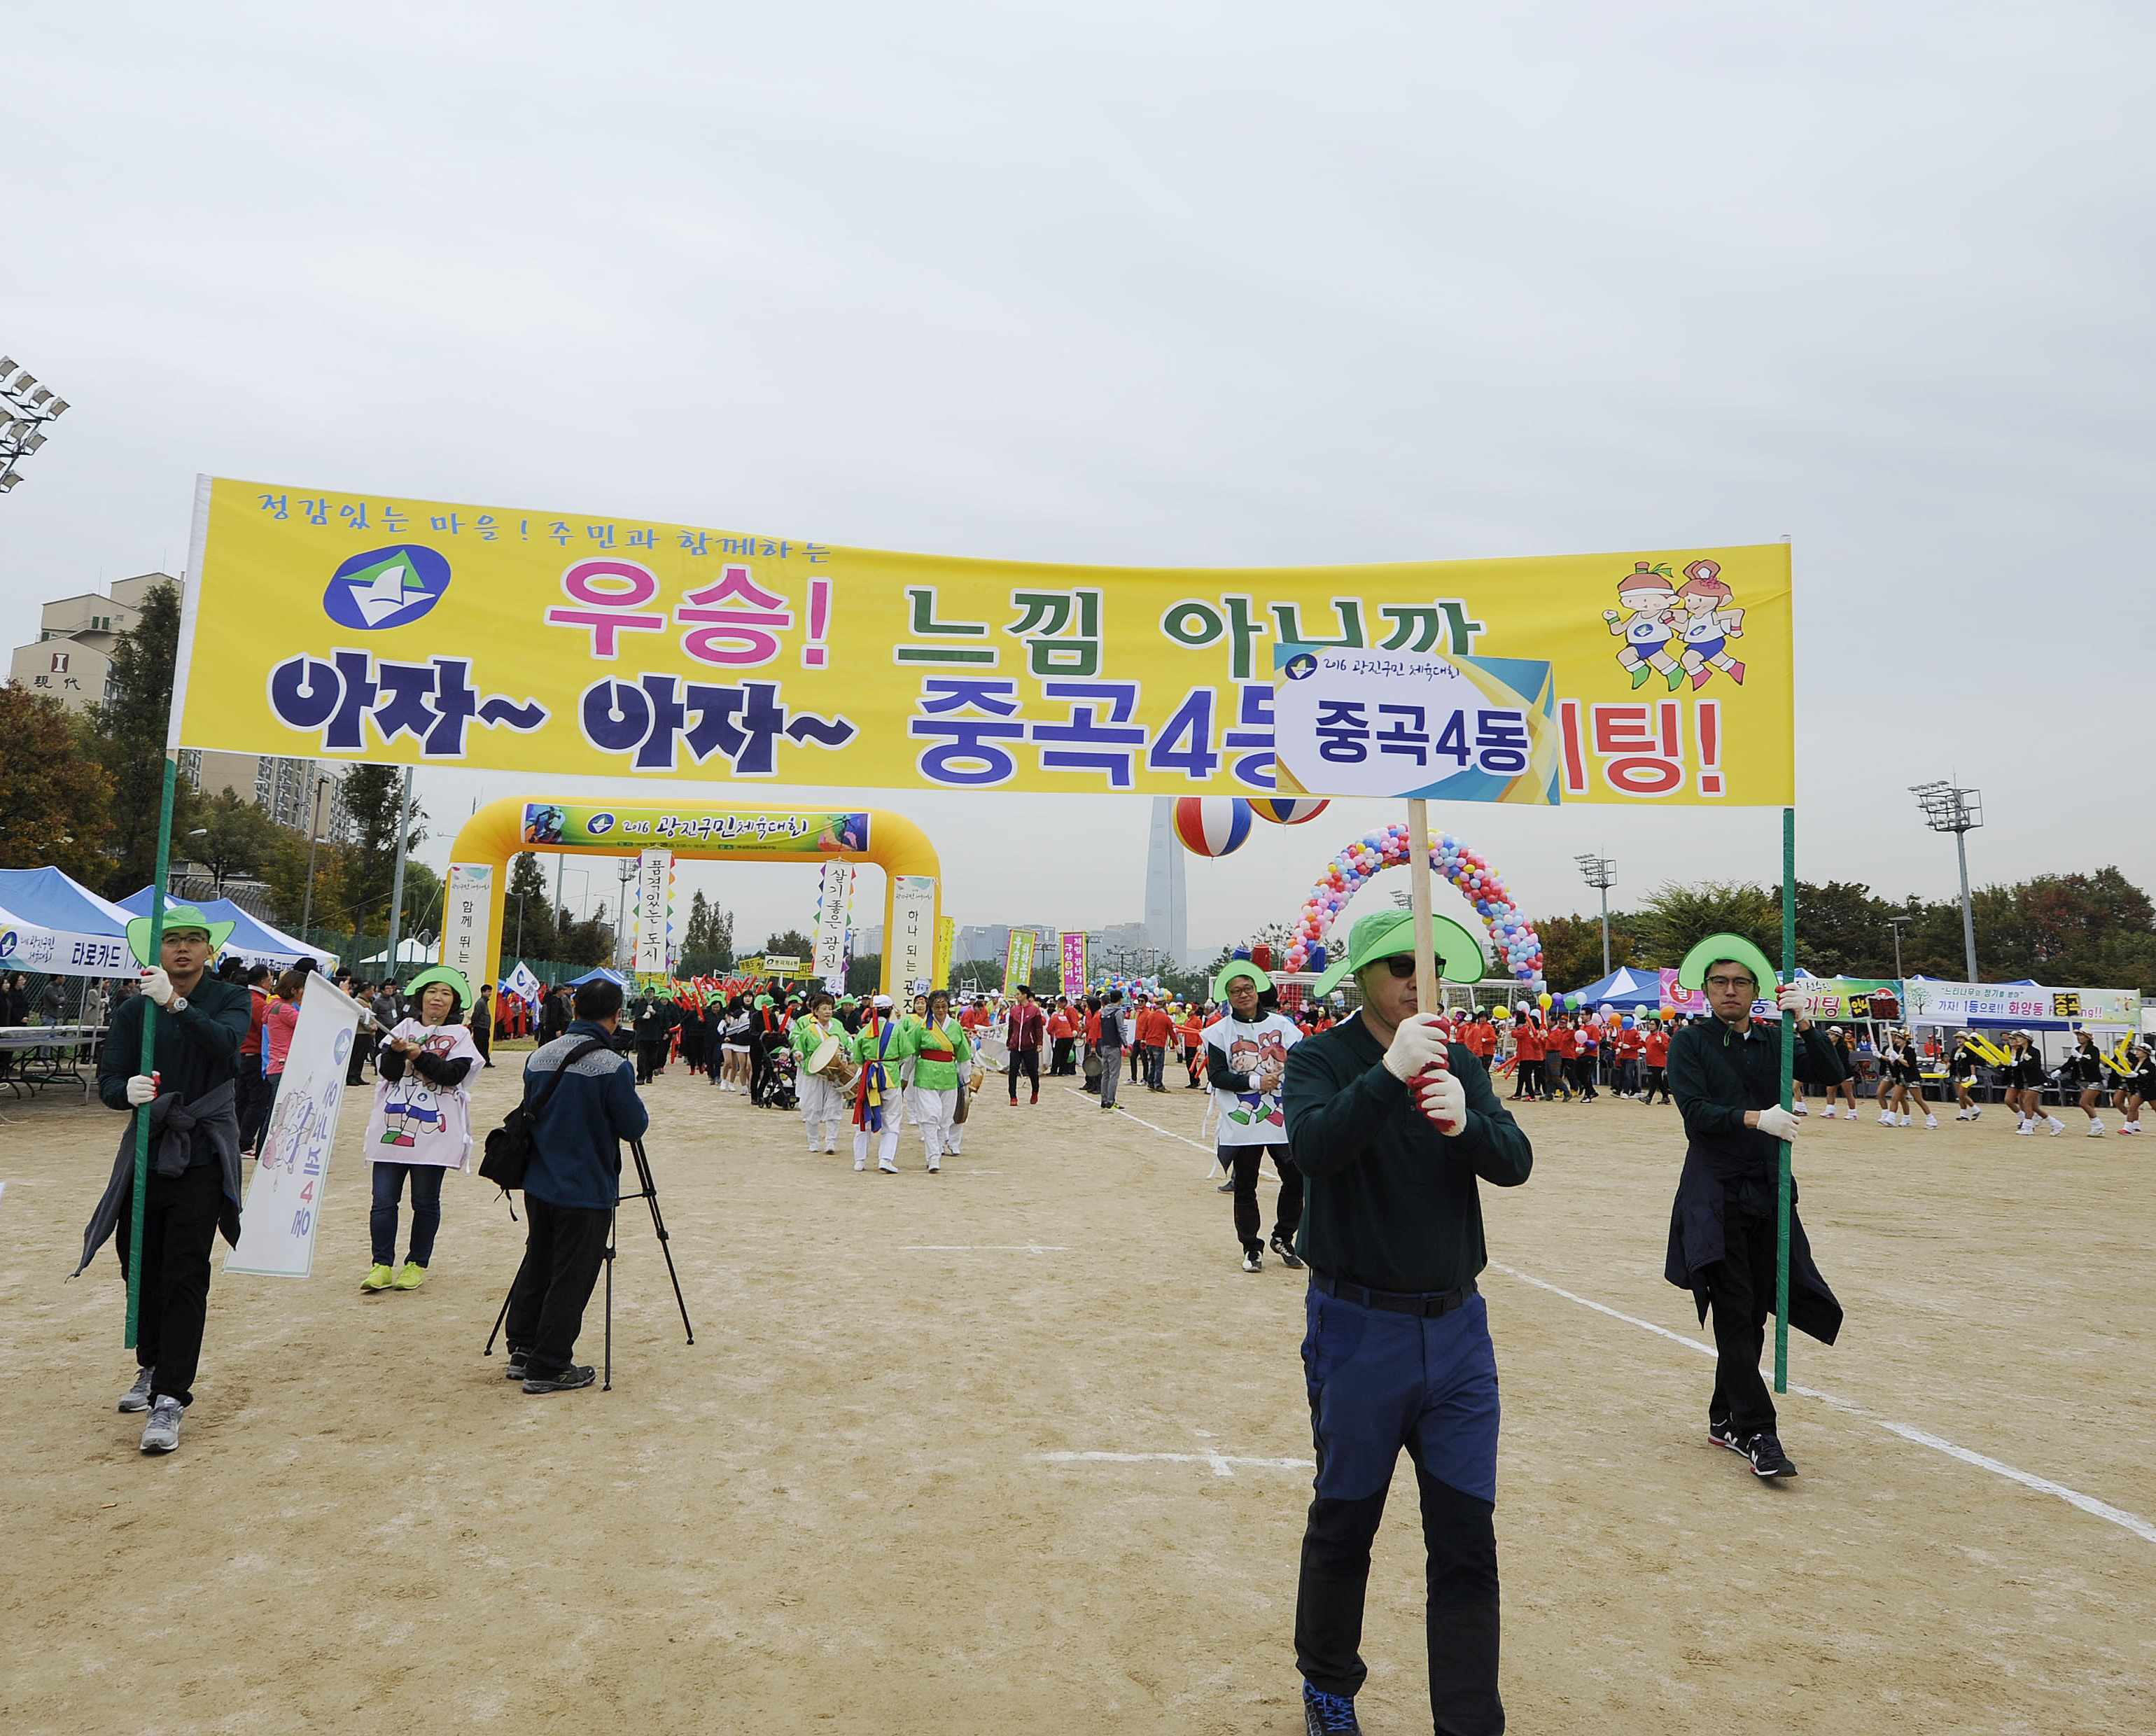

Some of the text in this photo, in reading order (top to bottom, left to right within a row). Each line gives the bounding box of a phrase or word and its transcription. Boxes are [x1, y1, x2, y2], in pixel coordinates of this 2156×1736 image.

[258, 494, 410, 533] 정감있는
[547, 521, 661, 550] 주민과
[677, 530, 832, 564] 함께하는
[546, 559, 830, 666] 우승!
[897, 589, 1100, 676] 느낌
[1323, 659, 1346, 671] 2016
[271, 651, 547, 755] 아자~
[582, 674, 856, 774] 아자~
[1314, 699, 1529, 772] 중곡4동
[623, 820, 649, 833] 2016
[460, 900, 474, 928] 함께
[819, 868, 848, 969] 살기좋은 광진
[906, 910, 919, 937] 하나
[71, 942, 121, 967] 타로카드
[458, 935, 471, 964] 뛰는
[641, 932, 662, 963] 도시
[905, 945, 918, 972] 되는
[2008, 1001, 2043, 1016] 화양동
